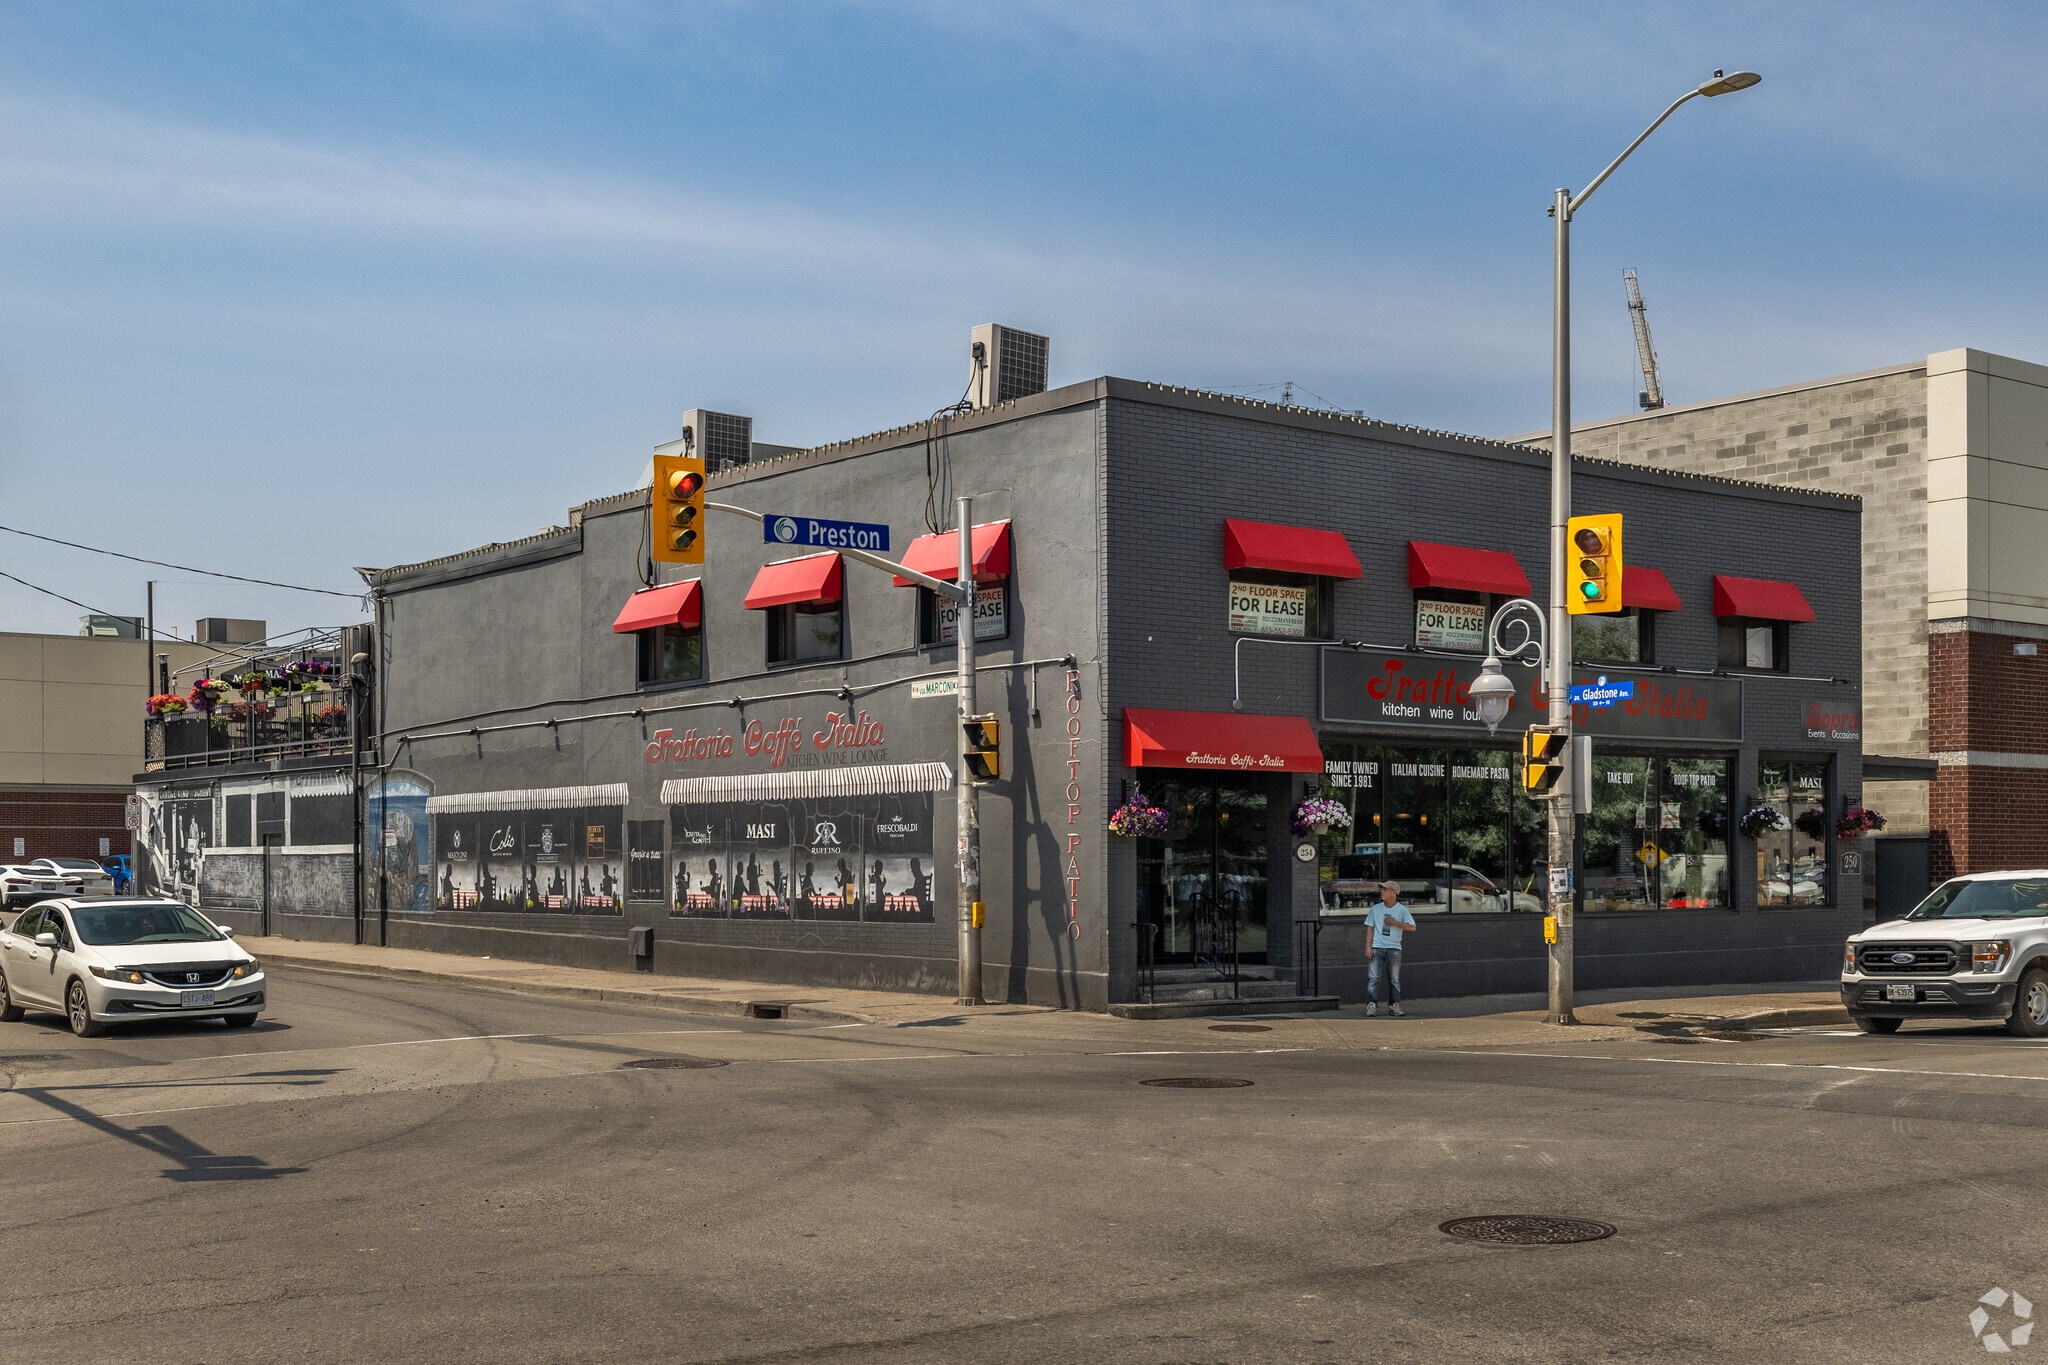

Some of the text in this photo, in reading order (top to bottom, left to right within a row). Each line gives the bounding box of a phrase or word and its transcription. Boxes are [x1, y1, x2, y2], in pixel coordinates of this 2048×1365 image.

[809, 520, 881, 549] Preston
[977, 590, 1002, 602] SPACE
[1249, 587, 1278, 598] FLOOR
[1280, 589, 1305, 600] SPACE
[973, 602, 1003, 619] EASE
[1231, 596, 1304, 616] FOR LEASE
[1435, 604, 1461, 615] FLOOR
[1462, 606, 1485, 617] SPACE
[1419, 613, 1483, 632] FOR LEASE
[926, 681, 955, 694] MARCONI
[1582, 687, 1618, 700] Gladstone
[1624, 678, 1708, 720] Italia
[1382, 702, 1420, 718] kitchen
[1430, 707, 1454, 720] wine
[1805, 702, 1858, 736] Sopra
[646, 728, 734, 763] Trattoria
[812, 709, 885, 749] Italia
[1808, 729, 1859, 739] Events Occasions
[786, 749, 889, 768] KITCHEN WINE LOUNGE
[1186, 751, 1226, 765] Trattoria
[1259, 754, 1284, 767] Italia
[1325, 760, 1378, 775] FAMILY OWNED
[1391, 763, 1445, 777] ITALIAN CUISINE
[1452, 765, 1510, 780] HOMEMADE PASTA
[1331, 774, 1373, 788] SINCE 1981
[1607, 771, 1634, 784] TAKE OUT
[1673, 774, 1716, 786] ROOF TOP PATIO
[1799, 776, 1822, 789] MASI
[1066, 669, 1081, 941] ROOFTOP PATIO
[746, 823, 776, 839] MASI
[877, 823, 918, 833] FRESCOBALDI
[489, 825, 515, 852] Colio
[811, 846, 841, 855] RUFFINO
[1300, 848, 1313, 857] 254
[1844, 855, 1858, 868] 250
